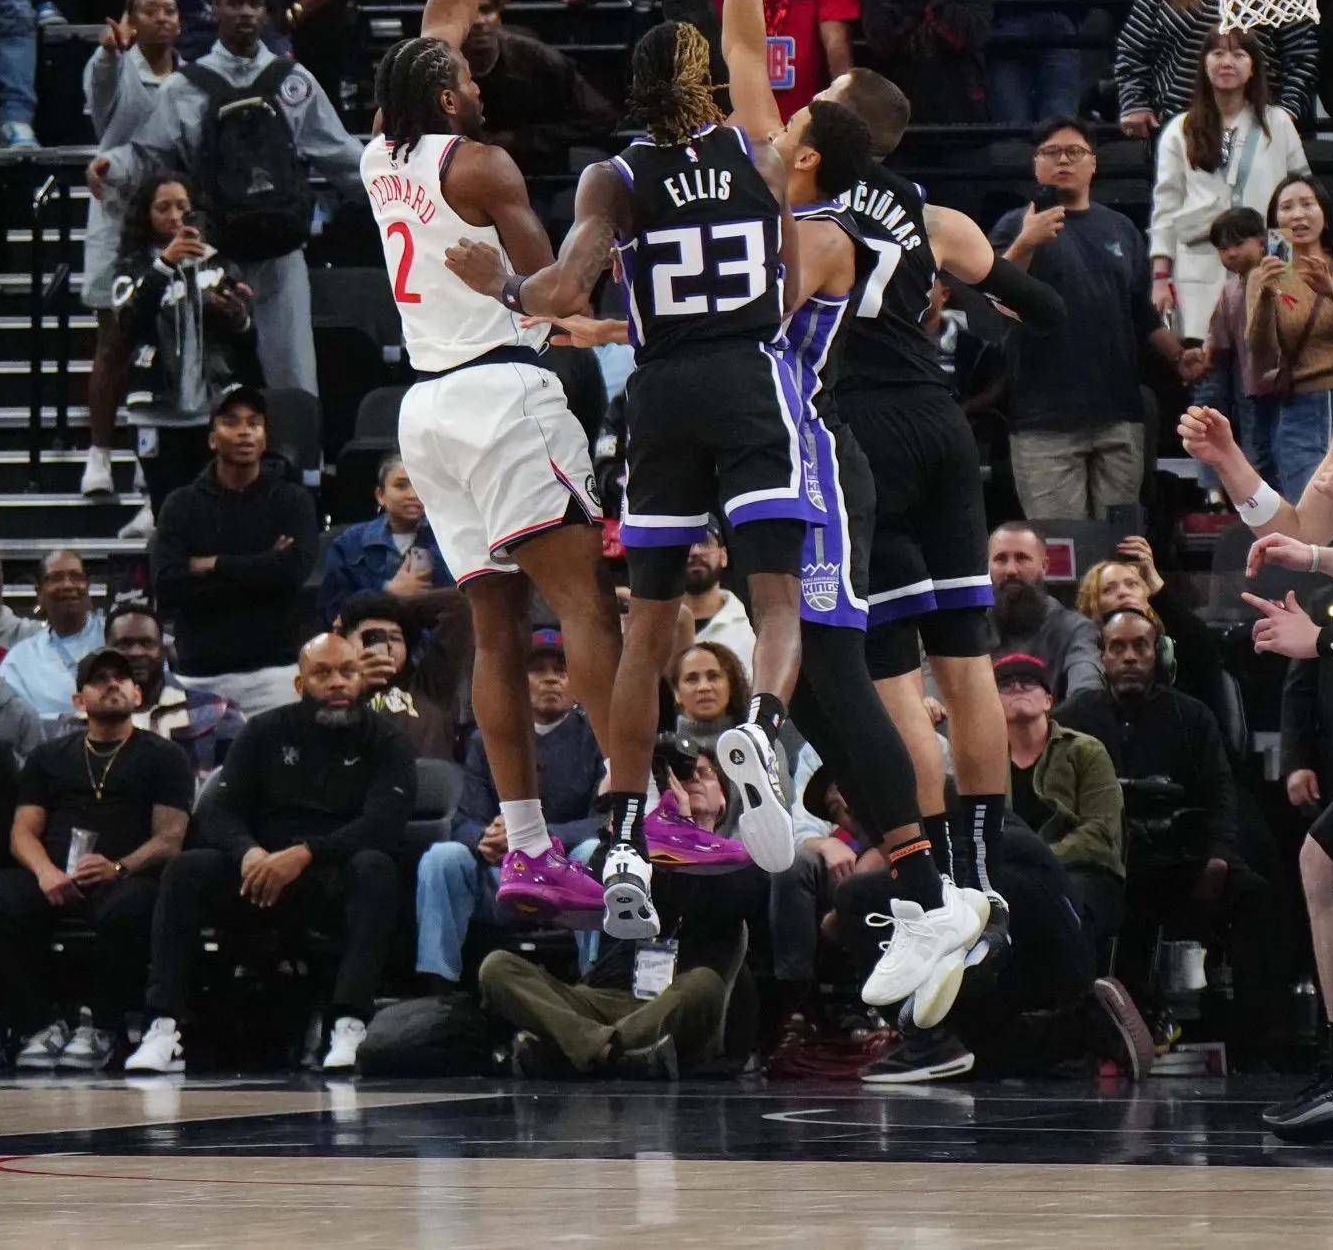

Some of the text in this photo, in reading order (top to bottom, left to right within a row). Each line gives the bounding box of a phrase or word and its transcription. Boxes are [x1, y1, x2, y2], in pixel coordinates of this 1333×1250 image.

[369, 174, 437, 225] LEONARD
[662, 167, 733, 212] ELLIS
[386, 220, 421, 305] 2
[645, 220, 768, 318] 23
[802, 583, 841, 597] KINGS
